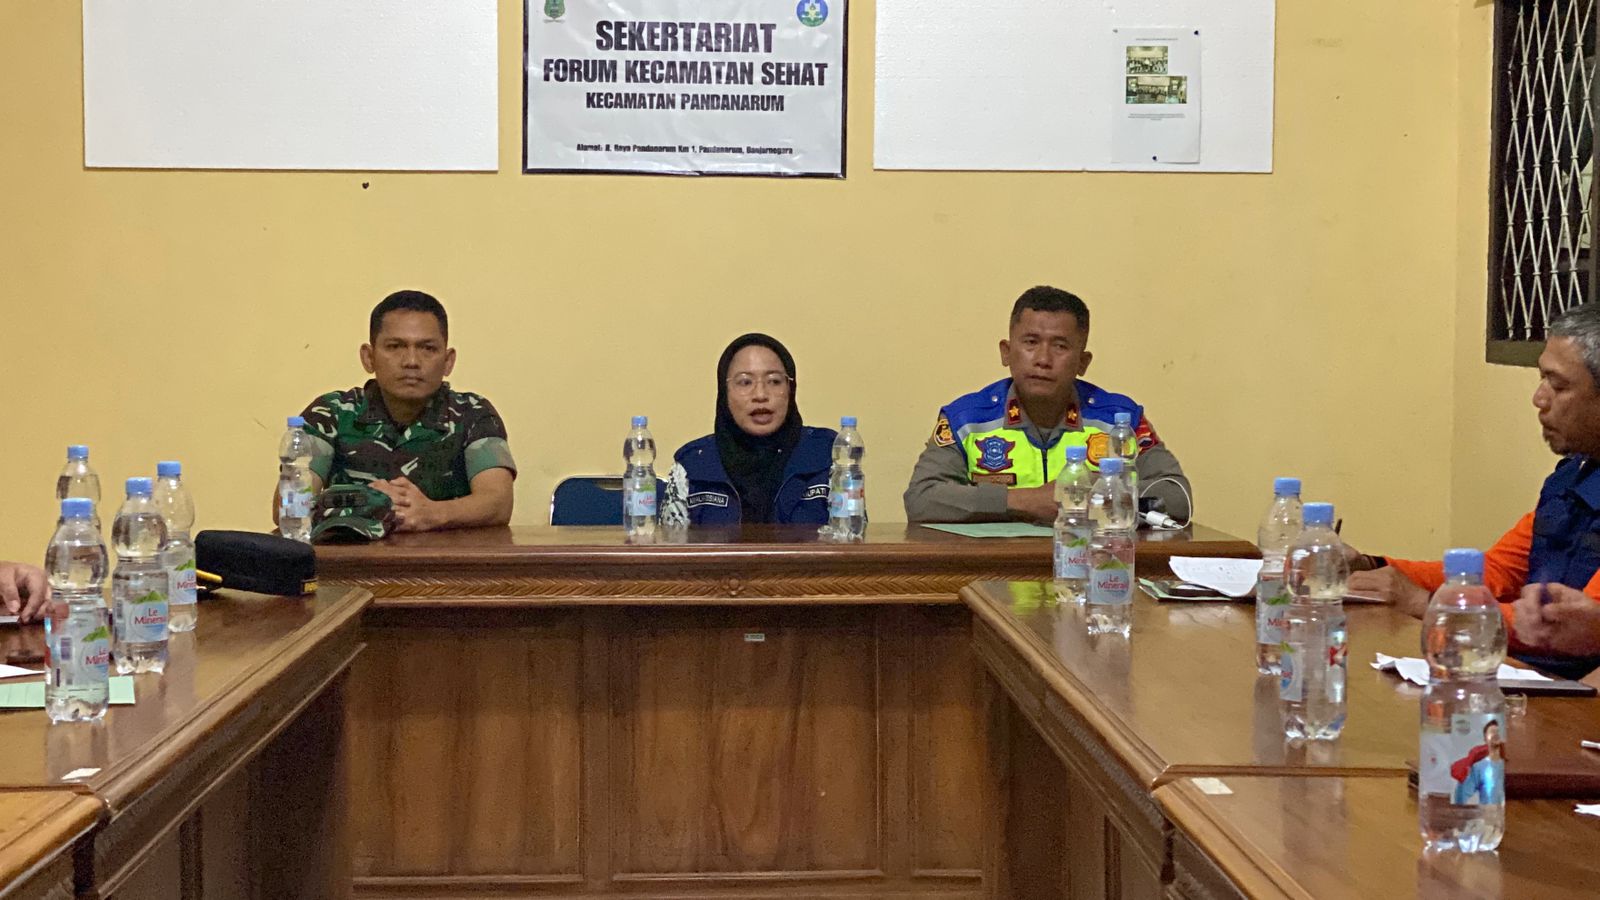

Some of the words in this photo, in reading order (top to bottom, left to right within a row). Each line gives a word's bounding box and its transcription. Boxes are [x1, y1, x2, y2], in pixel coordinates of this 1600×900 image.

[596, 20, 777, 53] SEKERTARIAT
[543, 58, 617, 83] FORUM
[624, 60, 754, 85] KECAMATAN
[761, 61, 828, 86] SEHAT
[586, 92, 676, 110] KECAMATAN
[681, 93, 785, 112] PANDANARUM
[148, 607, 159, 617] Le
